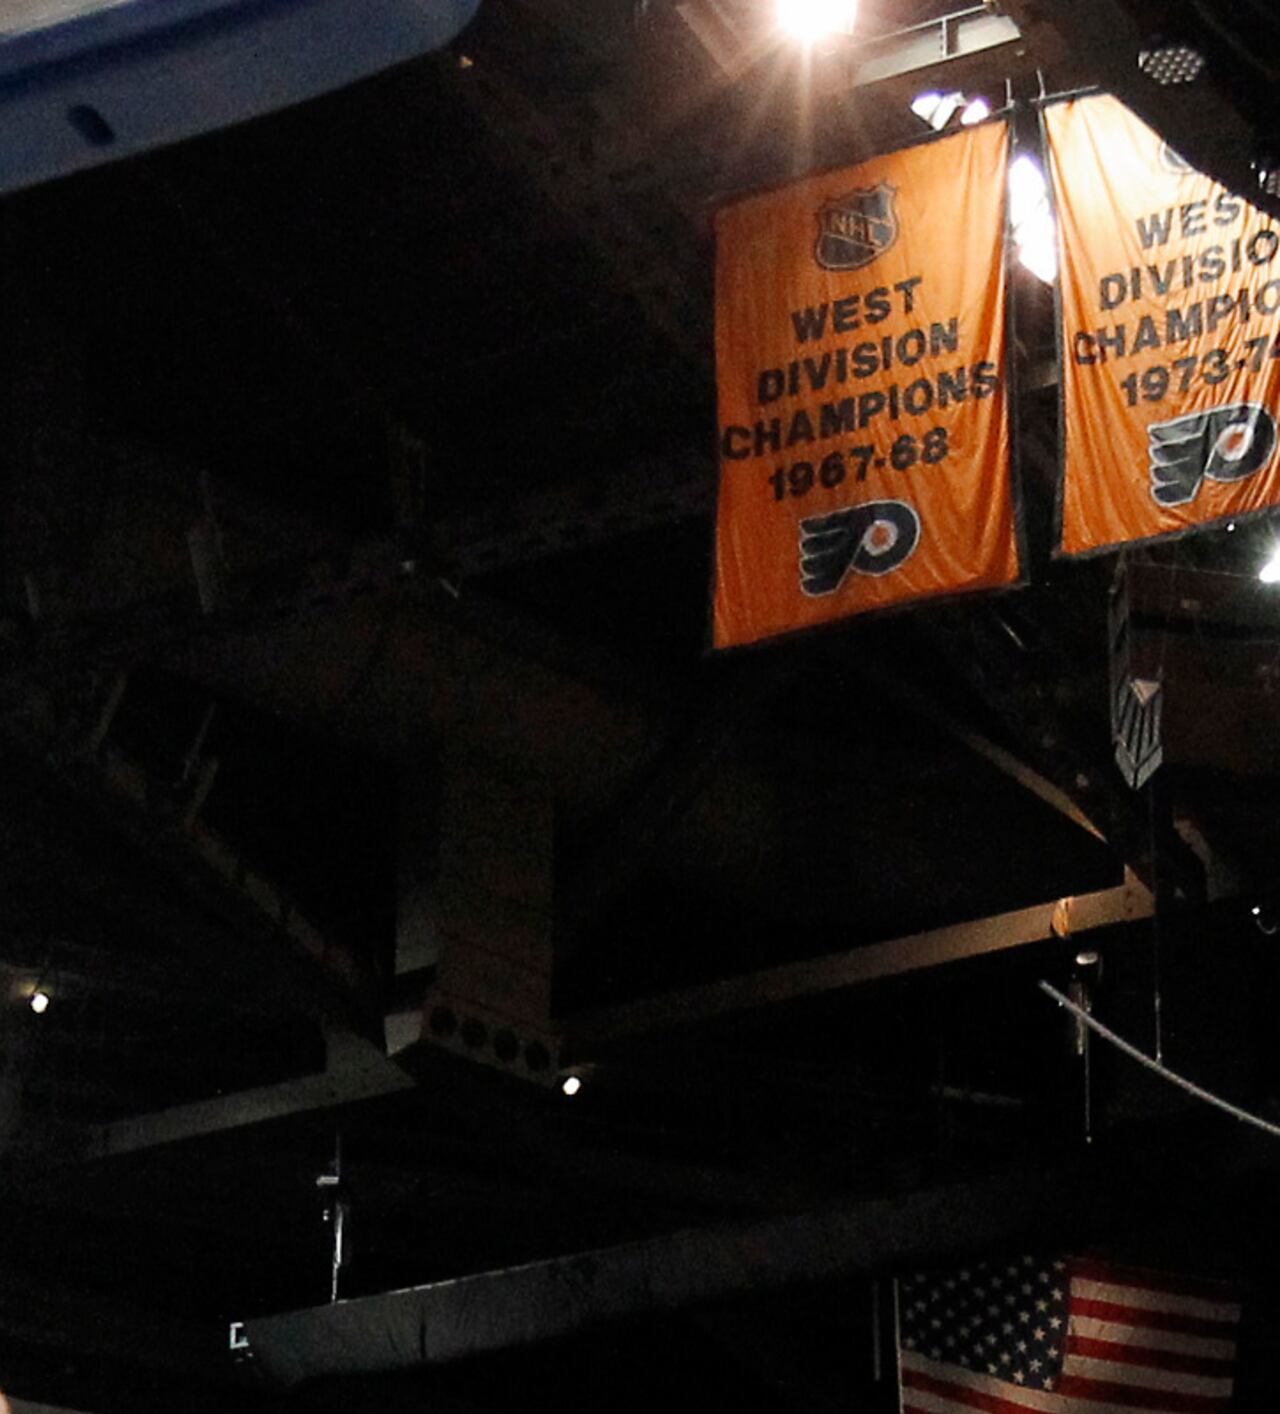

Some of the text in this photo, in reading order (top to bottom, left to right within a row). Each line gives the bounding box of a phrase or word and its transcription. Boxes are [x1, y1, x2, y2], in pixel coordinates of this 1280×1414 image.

[792, 277, 923, 345] WEST
[758, 319, 959, 406] DIVISION
[1120, 332, 1280, 407] 1973-7
[721, 361, 999, 463] CHAMPIONS
[768, 426, 949, 501] 1967-68
